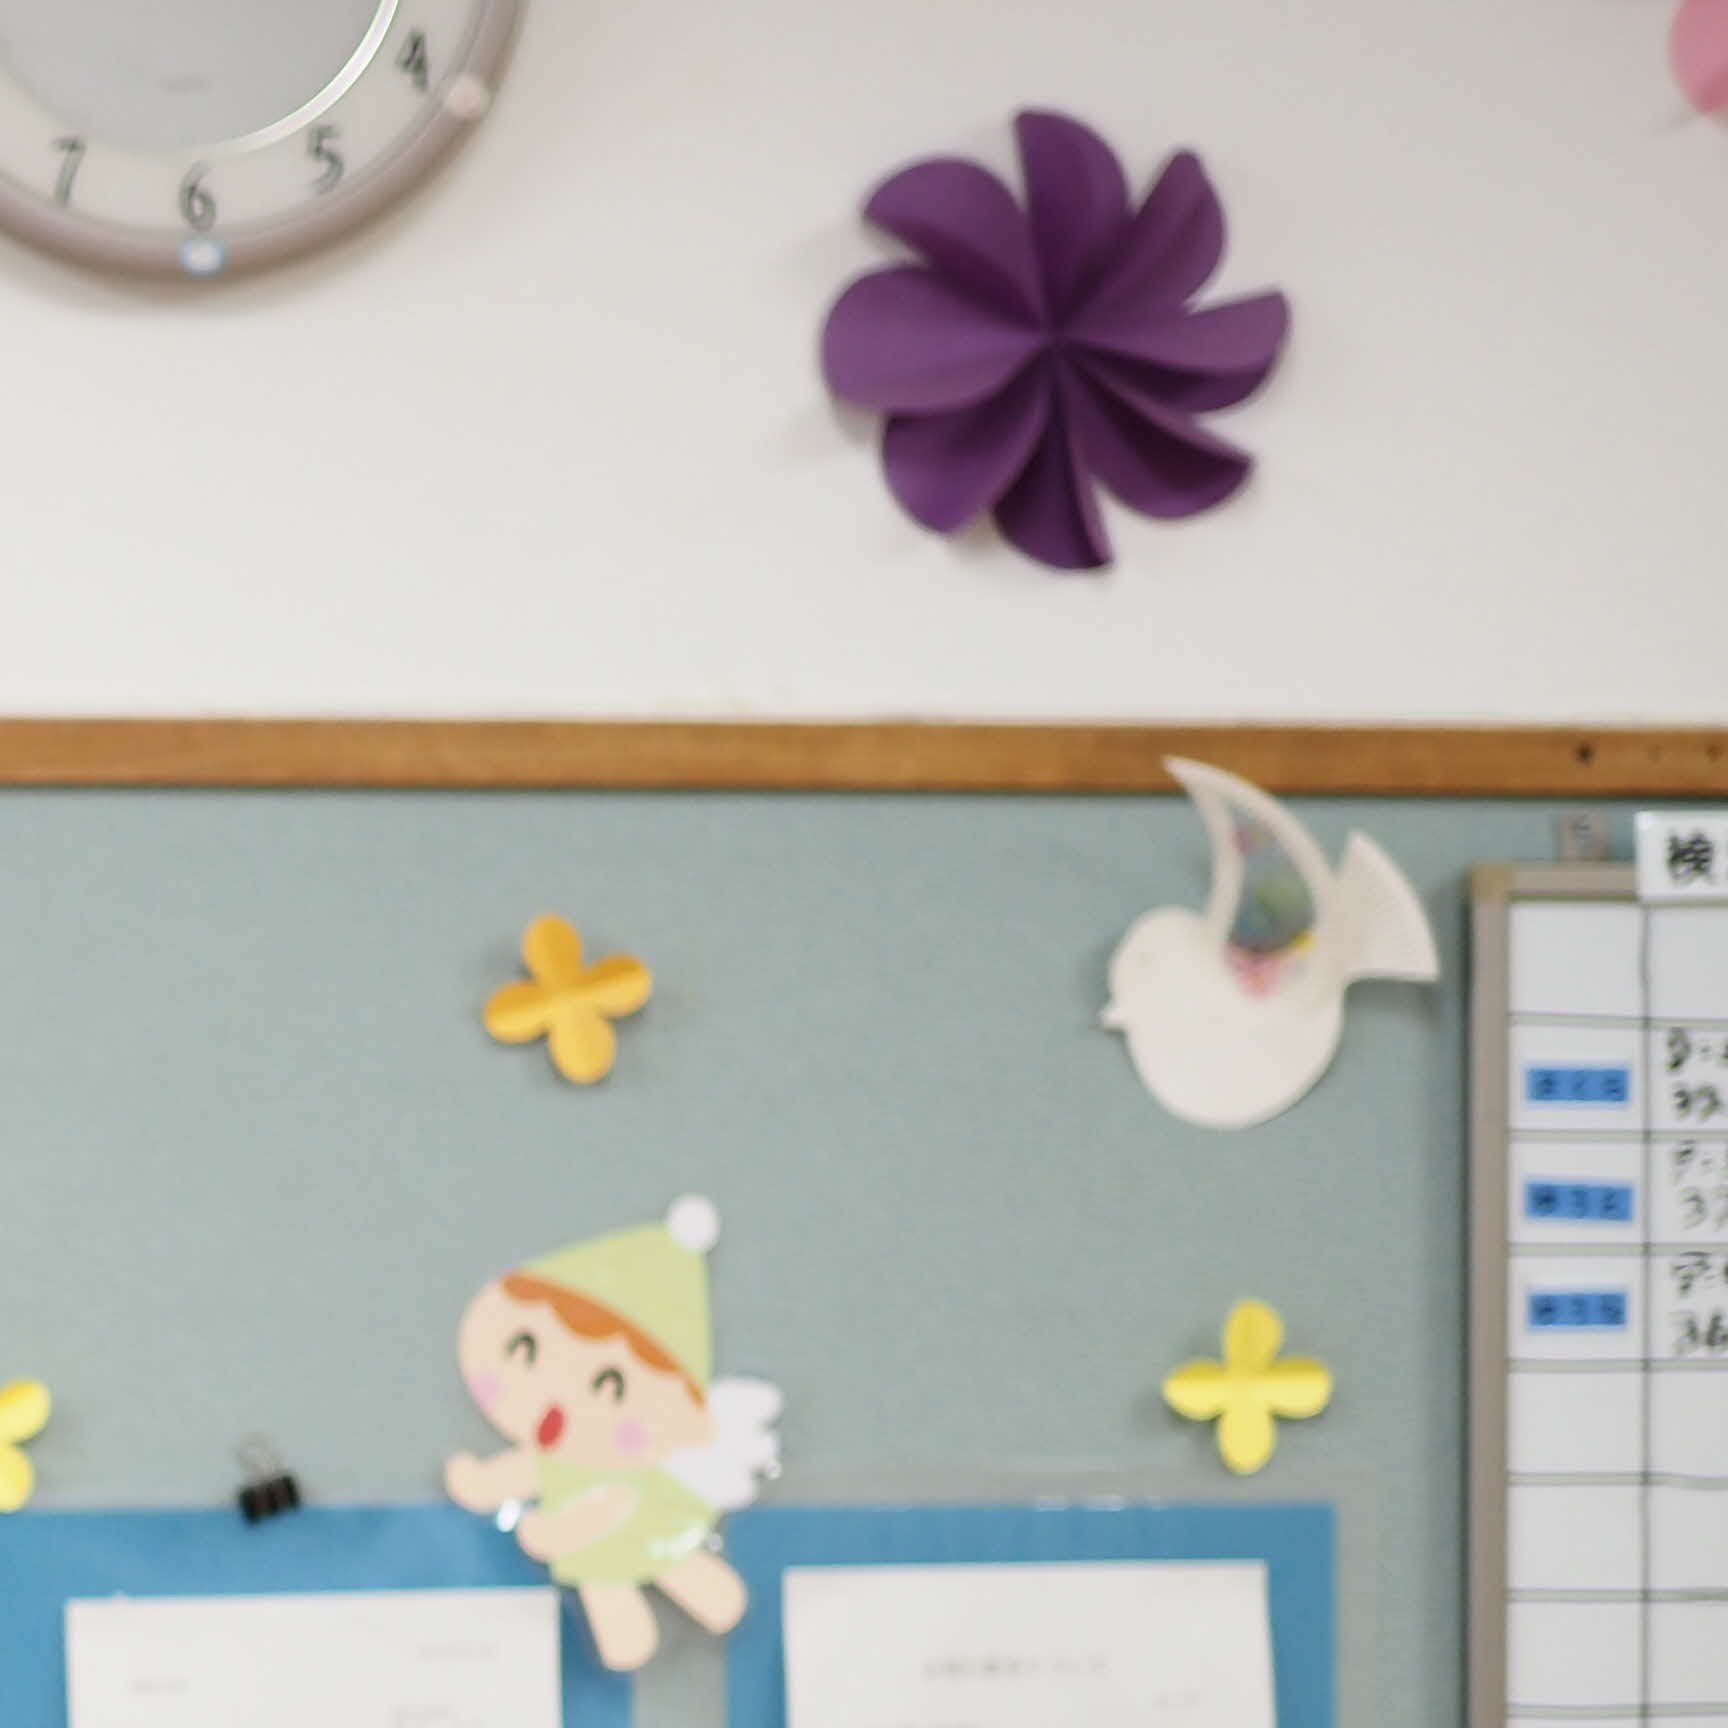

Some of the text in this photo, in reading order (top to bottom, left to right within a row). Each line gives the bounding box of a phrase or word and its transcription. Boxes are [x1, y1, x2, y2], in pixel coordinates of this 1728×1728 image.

[395, 26, 430, 93] 4
[52, 136, 87, 207] 7
[307, 123, 345, 193] 5
[178, 160, 216, 233] 6
